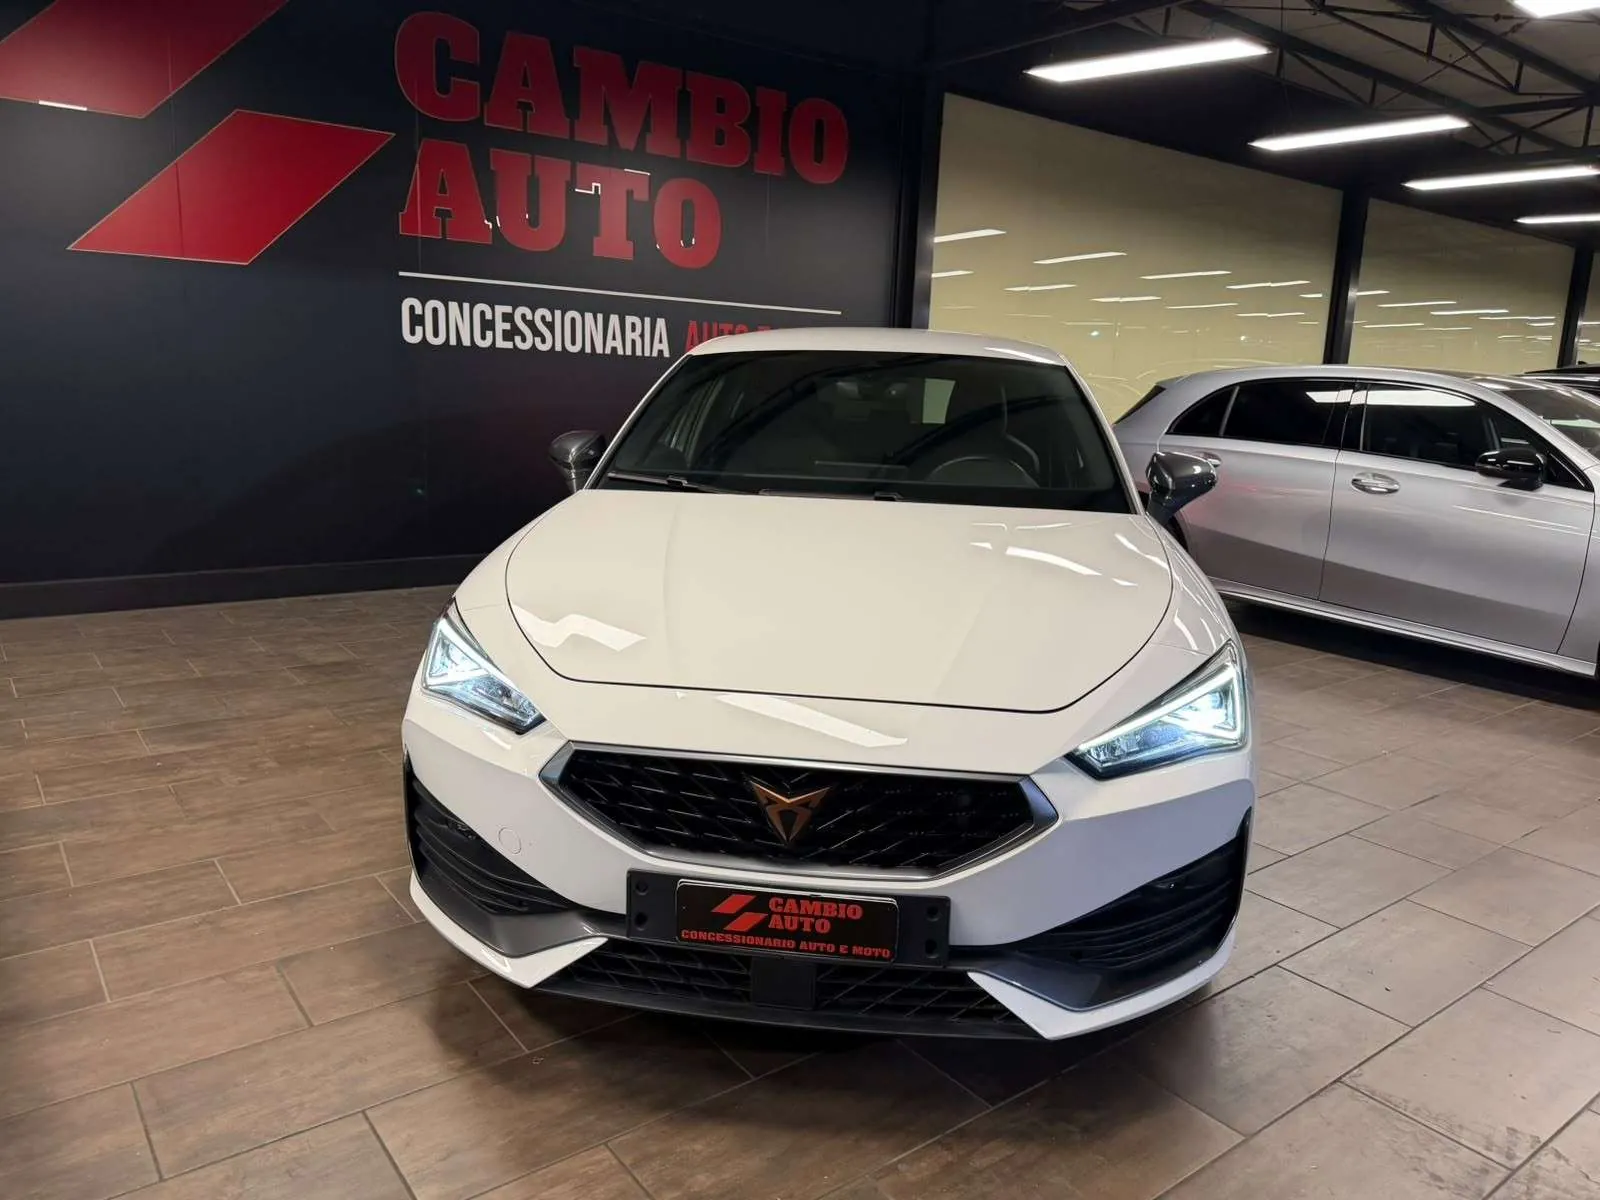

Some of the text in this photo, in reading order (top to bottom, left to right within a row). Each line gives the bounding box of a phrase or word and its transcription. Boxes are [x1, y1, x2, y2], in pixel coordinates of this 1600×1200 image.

[394, 11, 849, 184] CAMBIO
[399, 139, 722, 268] AUTO
[401, 297, 670, 358] CONCESSIONARIA
[768, 897, 863, 920] CAMBIO
[768, 914, 831, 934] AUTO
[681, 929, 890, 959] CONCESSIONARIO AUTO E MOTO
